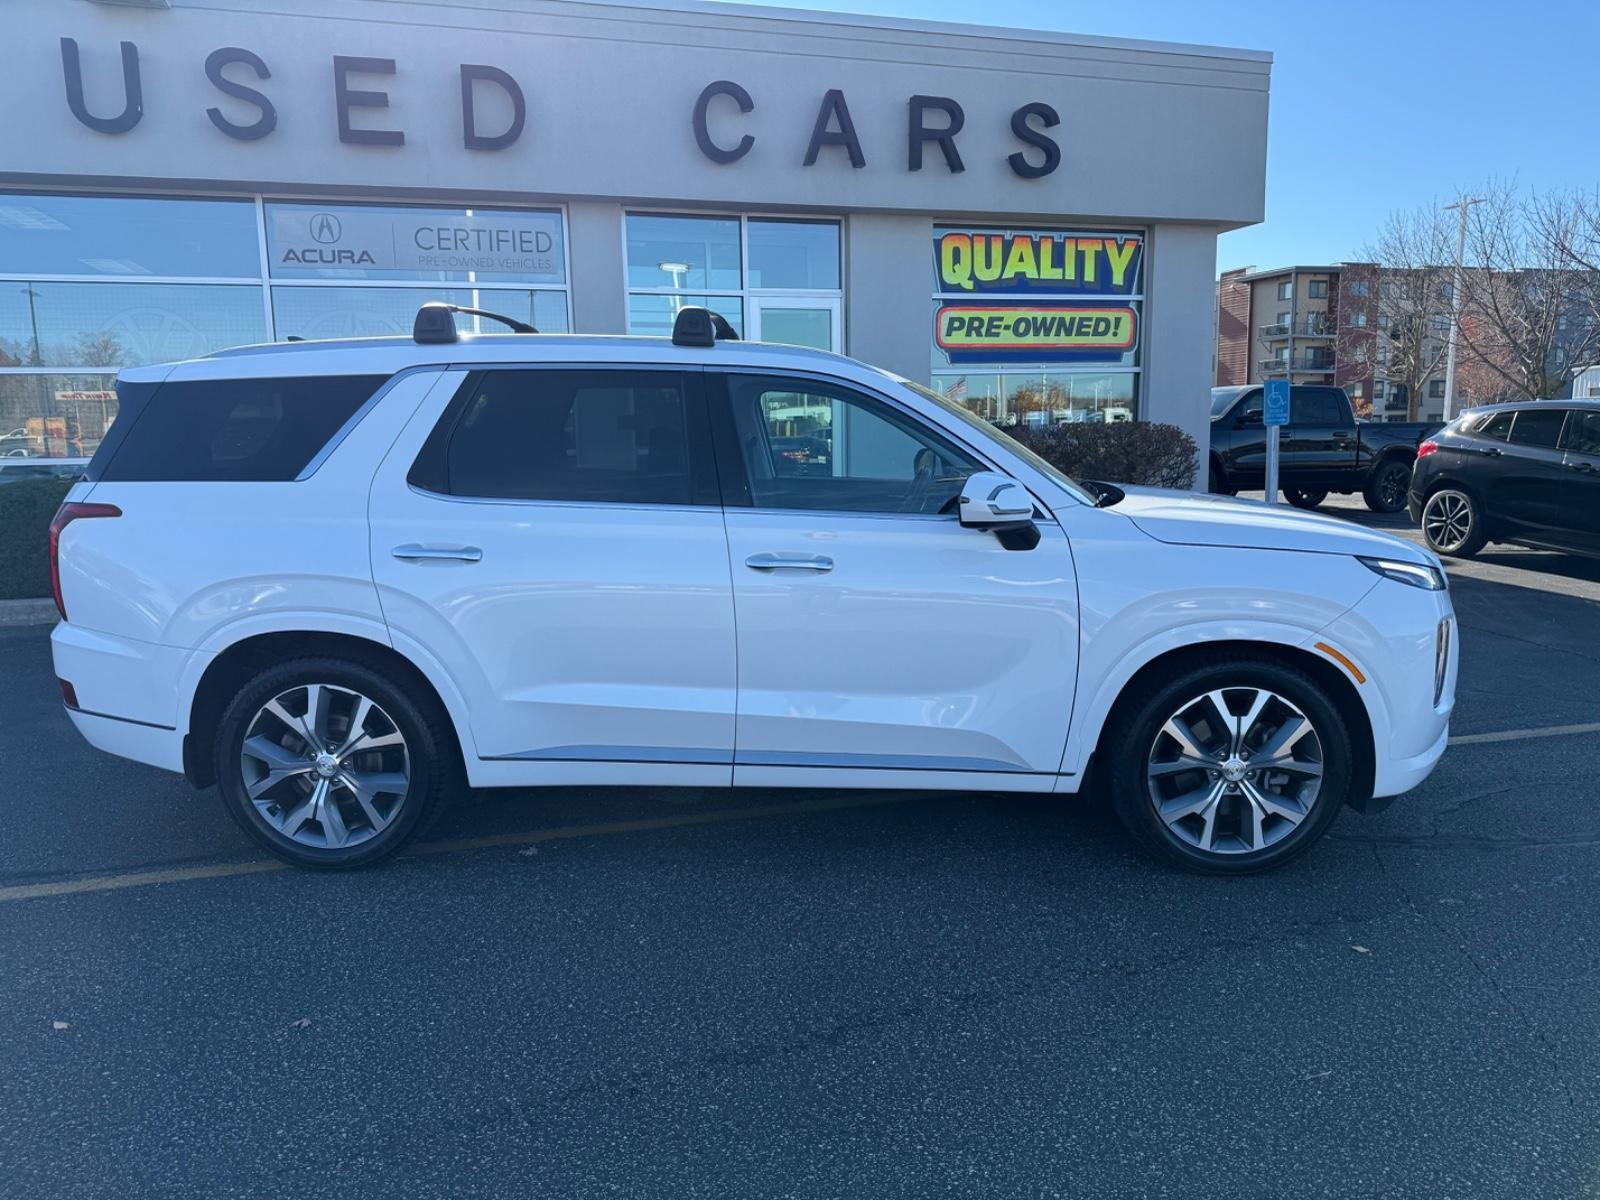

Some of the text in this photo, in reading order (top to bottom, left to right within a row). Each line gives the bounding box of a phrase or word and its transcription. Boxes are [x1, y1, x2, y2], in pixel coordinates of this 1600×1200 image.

[60, 37, 1061, 179] USED CARS
[414, 227, 553, 253] CERTIFIED
[282, 248, 376, 265] ACURA
[418, 255, 552, 270] PRE-OWNED VEHICLES
[941, 233, 1137, 290] QUALITY
[945, 316, 1122, 338] PRE-OWNED!
